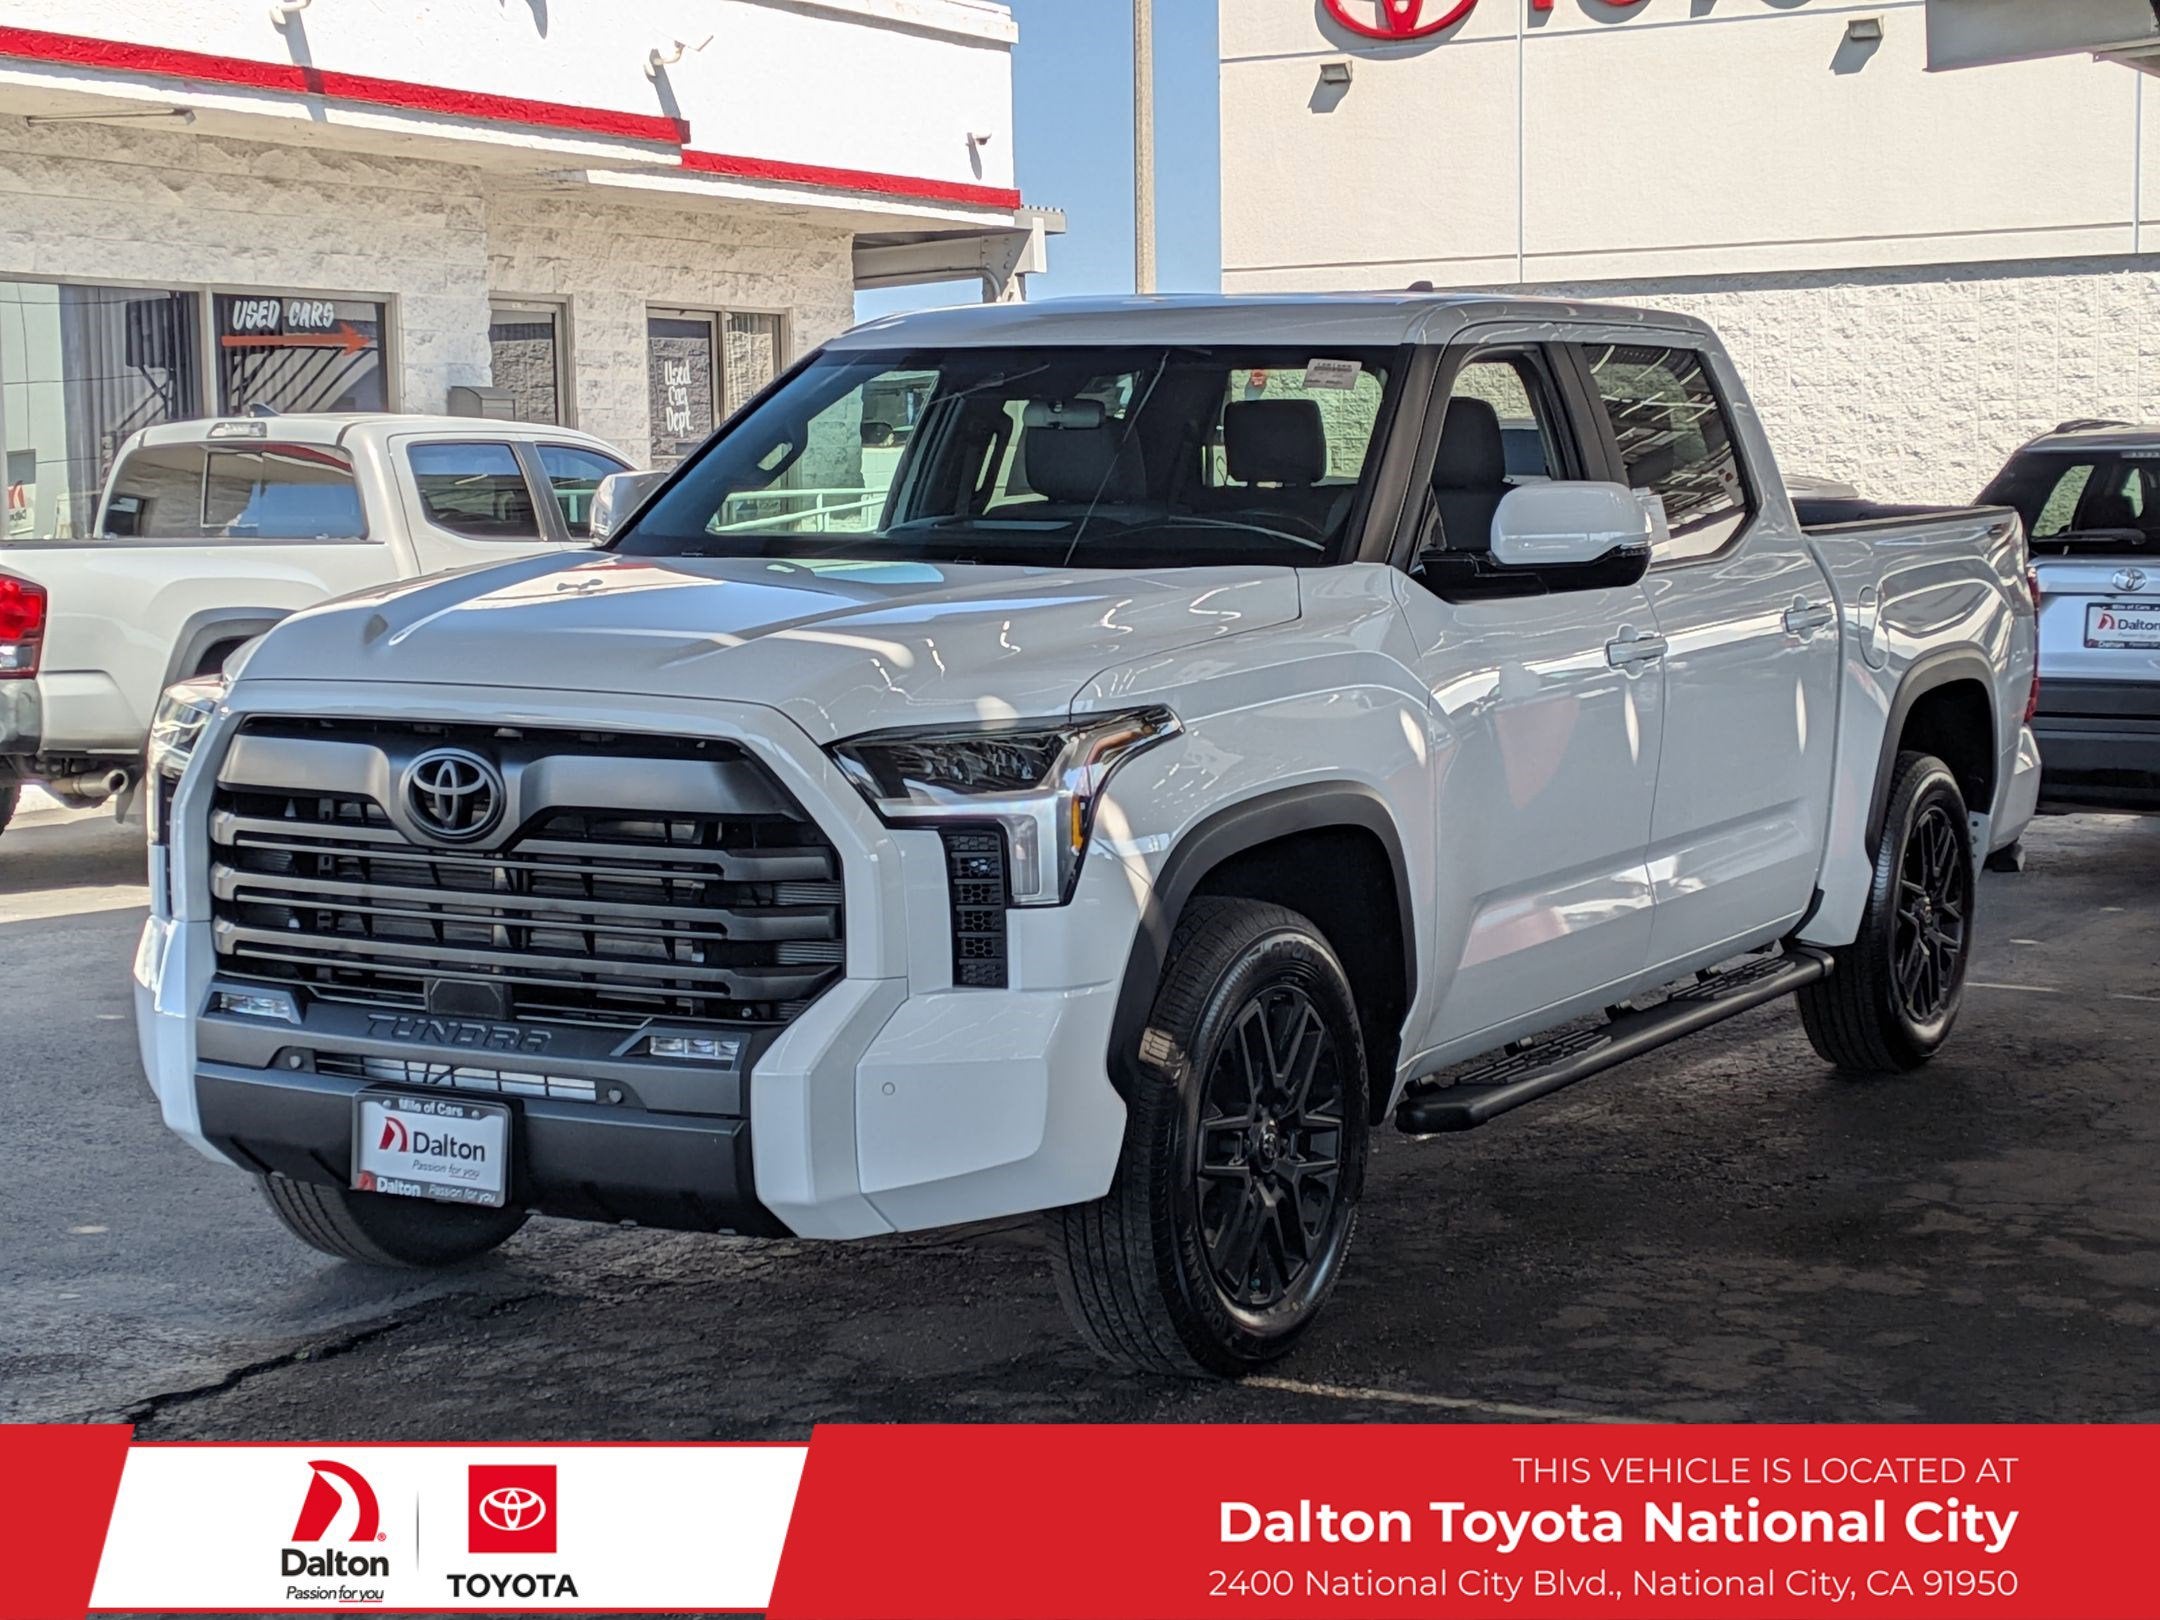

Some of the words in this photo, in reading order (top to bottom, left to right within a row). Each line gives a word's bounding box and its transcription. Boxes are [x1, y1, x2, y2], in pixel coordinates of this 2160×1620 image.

[232, 300, 280, 330] USED
[288, 301, 335, 328] CARS
[664, 359, 692, 386] Used
[2118, 618, 2160, 631] Dalton
[367, 1013, 552, 1052] TUNDRA
[398, 1098, 422, 1112] Mile
[423, 1102, 436, 1114] of
[437, 1103, 464, 1117] Cars
[412, 1130, 486, 1162] Dalton
[412, 1159, 446, 1174] Passion
[448, 1164, 462, 1175] for
[462, 1170, 480, 1179] you
[376, 1176, 421, 1197] Dalton
[428, 1184, 462, 1198] Passion
[464, 1188, 478, 1199] for
